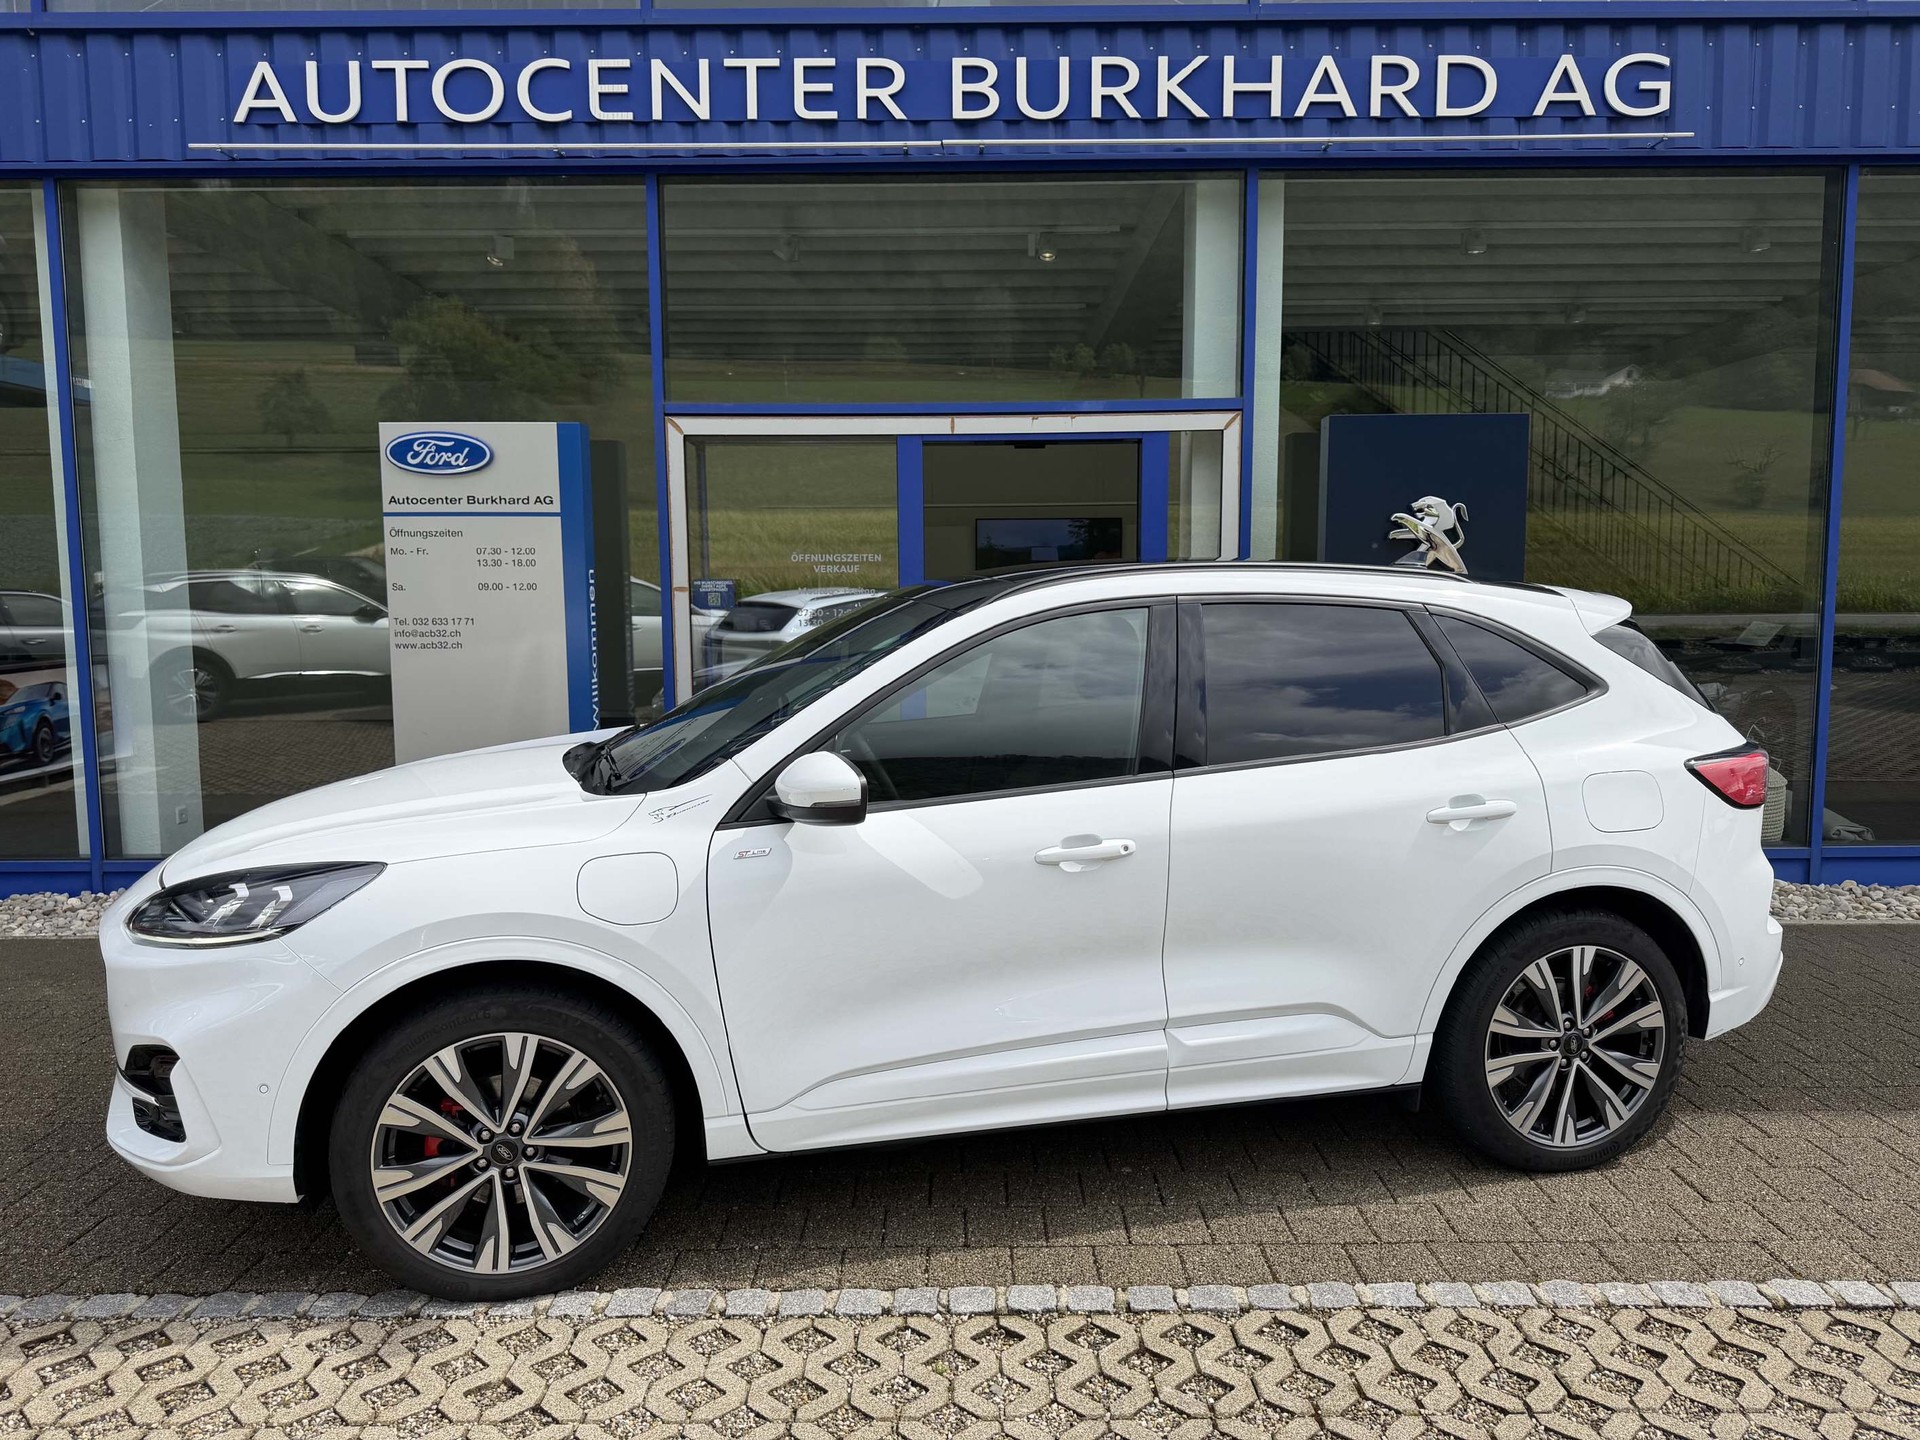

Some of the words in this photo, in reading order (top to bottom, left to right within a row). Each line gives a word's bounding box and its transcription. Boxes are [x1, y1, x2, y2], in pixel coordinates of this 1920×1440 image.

[233, 58, 908, 123] AUTOCENTER
[951, 55, 1497, 120] BURKHARD
[1532, 53, 1672, 117] AG
[407, 439, 470, 466] Ford
[388, 495, 463, 505] Autocenter
[466, 495, 530, 505] Burkhard
[533, 495, 554, 505] AG
[389, 528, 463, 539] Öffnungszeiten
[390, 547, 407, 555] Mo.
[416, 547, 429, 555] Fr.
[476, 547, 502, 555] 07.30
[511, 547, 536, 555] 12.00
[791, 552, 882, 562] ÖFFNUNGSZEITEN
[477, 559, 502, 567] 13.30
[512, 559, 536, 567] 18.00
[813, 565, 860, 573] VERKAUF
[391, 583, 406, 591] Sa.
[478, 583, 503, 591] 09.00
[513, 583, 537, 591] 12.00
[393, 618, 410, 626] Tel.
[412, 618, 429, 626] 032
[431, 618, 449, 626] 633
[451, 618, 462, 626] 17
[464, 618, 475, 626] 71
[394, 629, 461, 638] info@acb32.ch
[394, 641, 463, 650] www.acb32.ch
